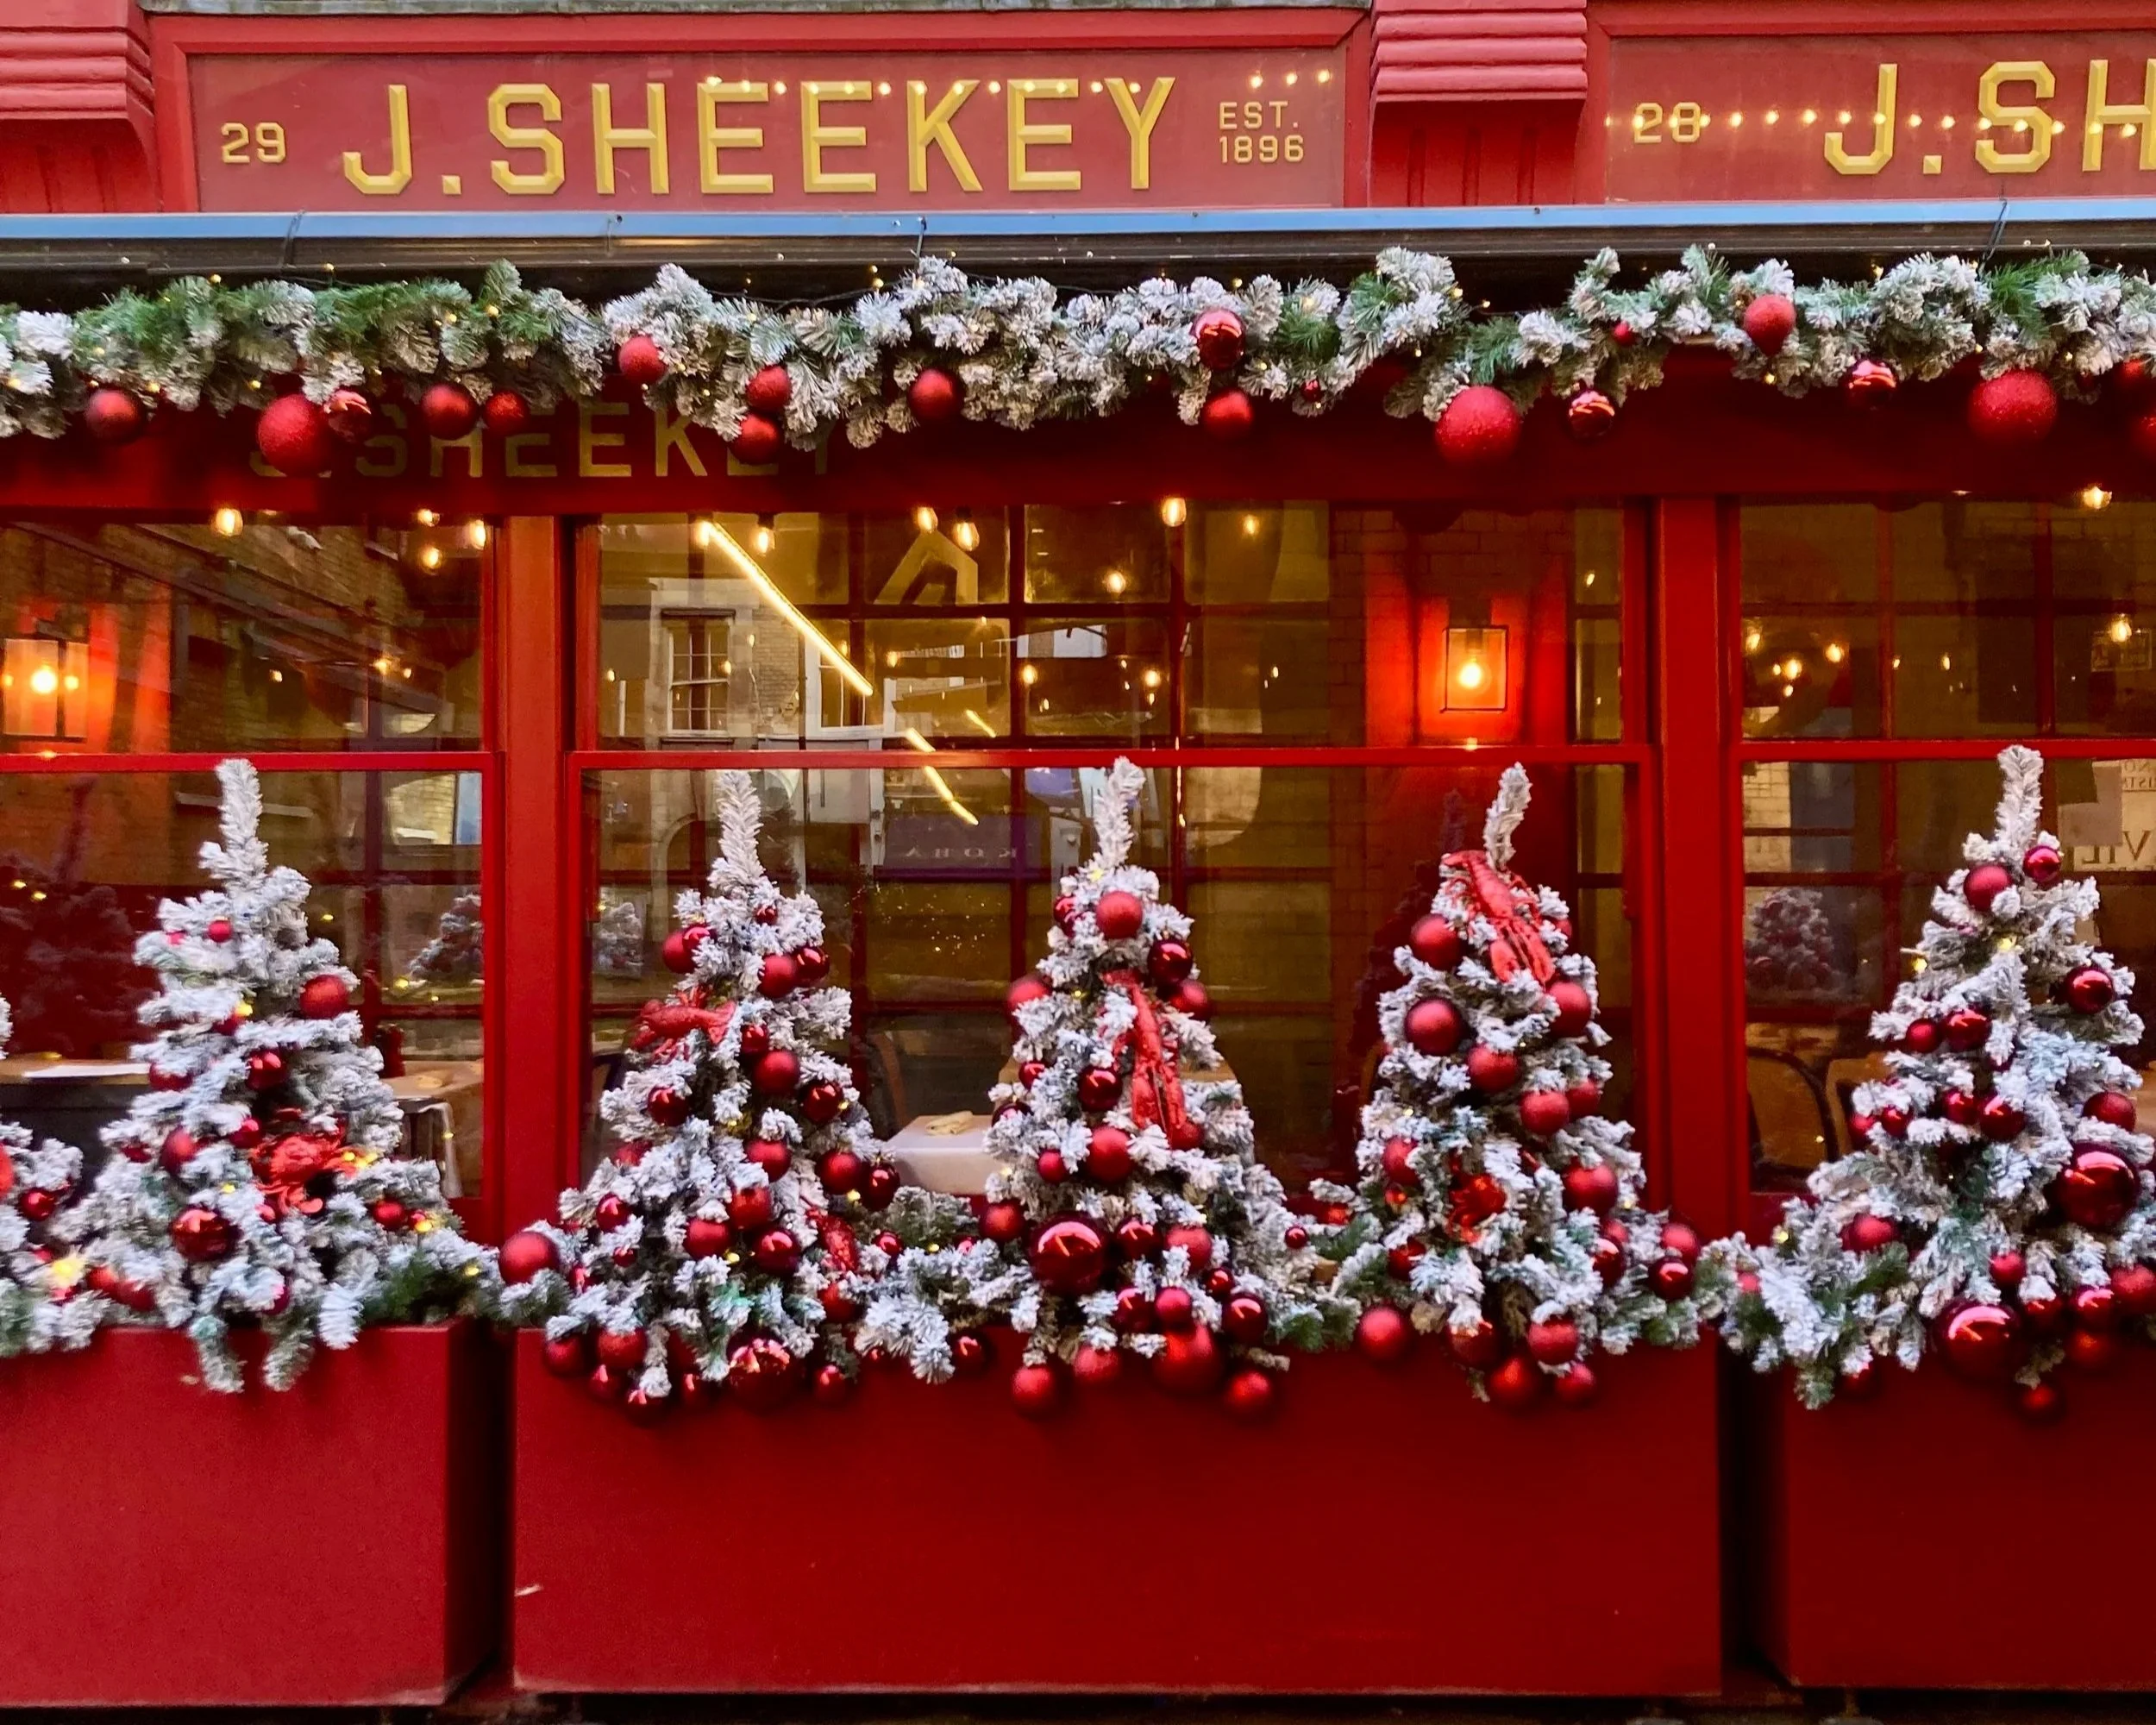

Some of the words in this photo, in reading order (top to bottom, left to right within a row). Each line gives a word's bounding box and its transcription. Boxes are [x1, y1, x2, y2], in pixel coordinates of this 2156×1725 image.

[1219, 101, 1299, 129] EST.
[1633, 101, 1702, 143] 28
[221, 122, 286, 164] 29
[1219, 135, 1305, 164] 1896
